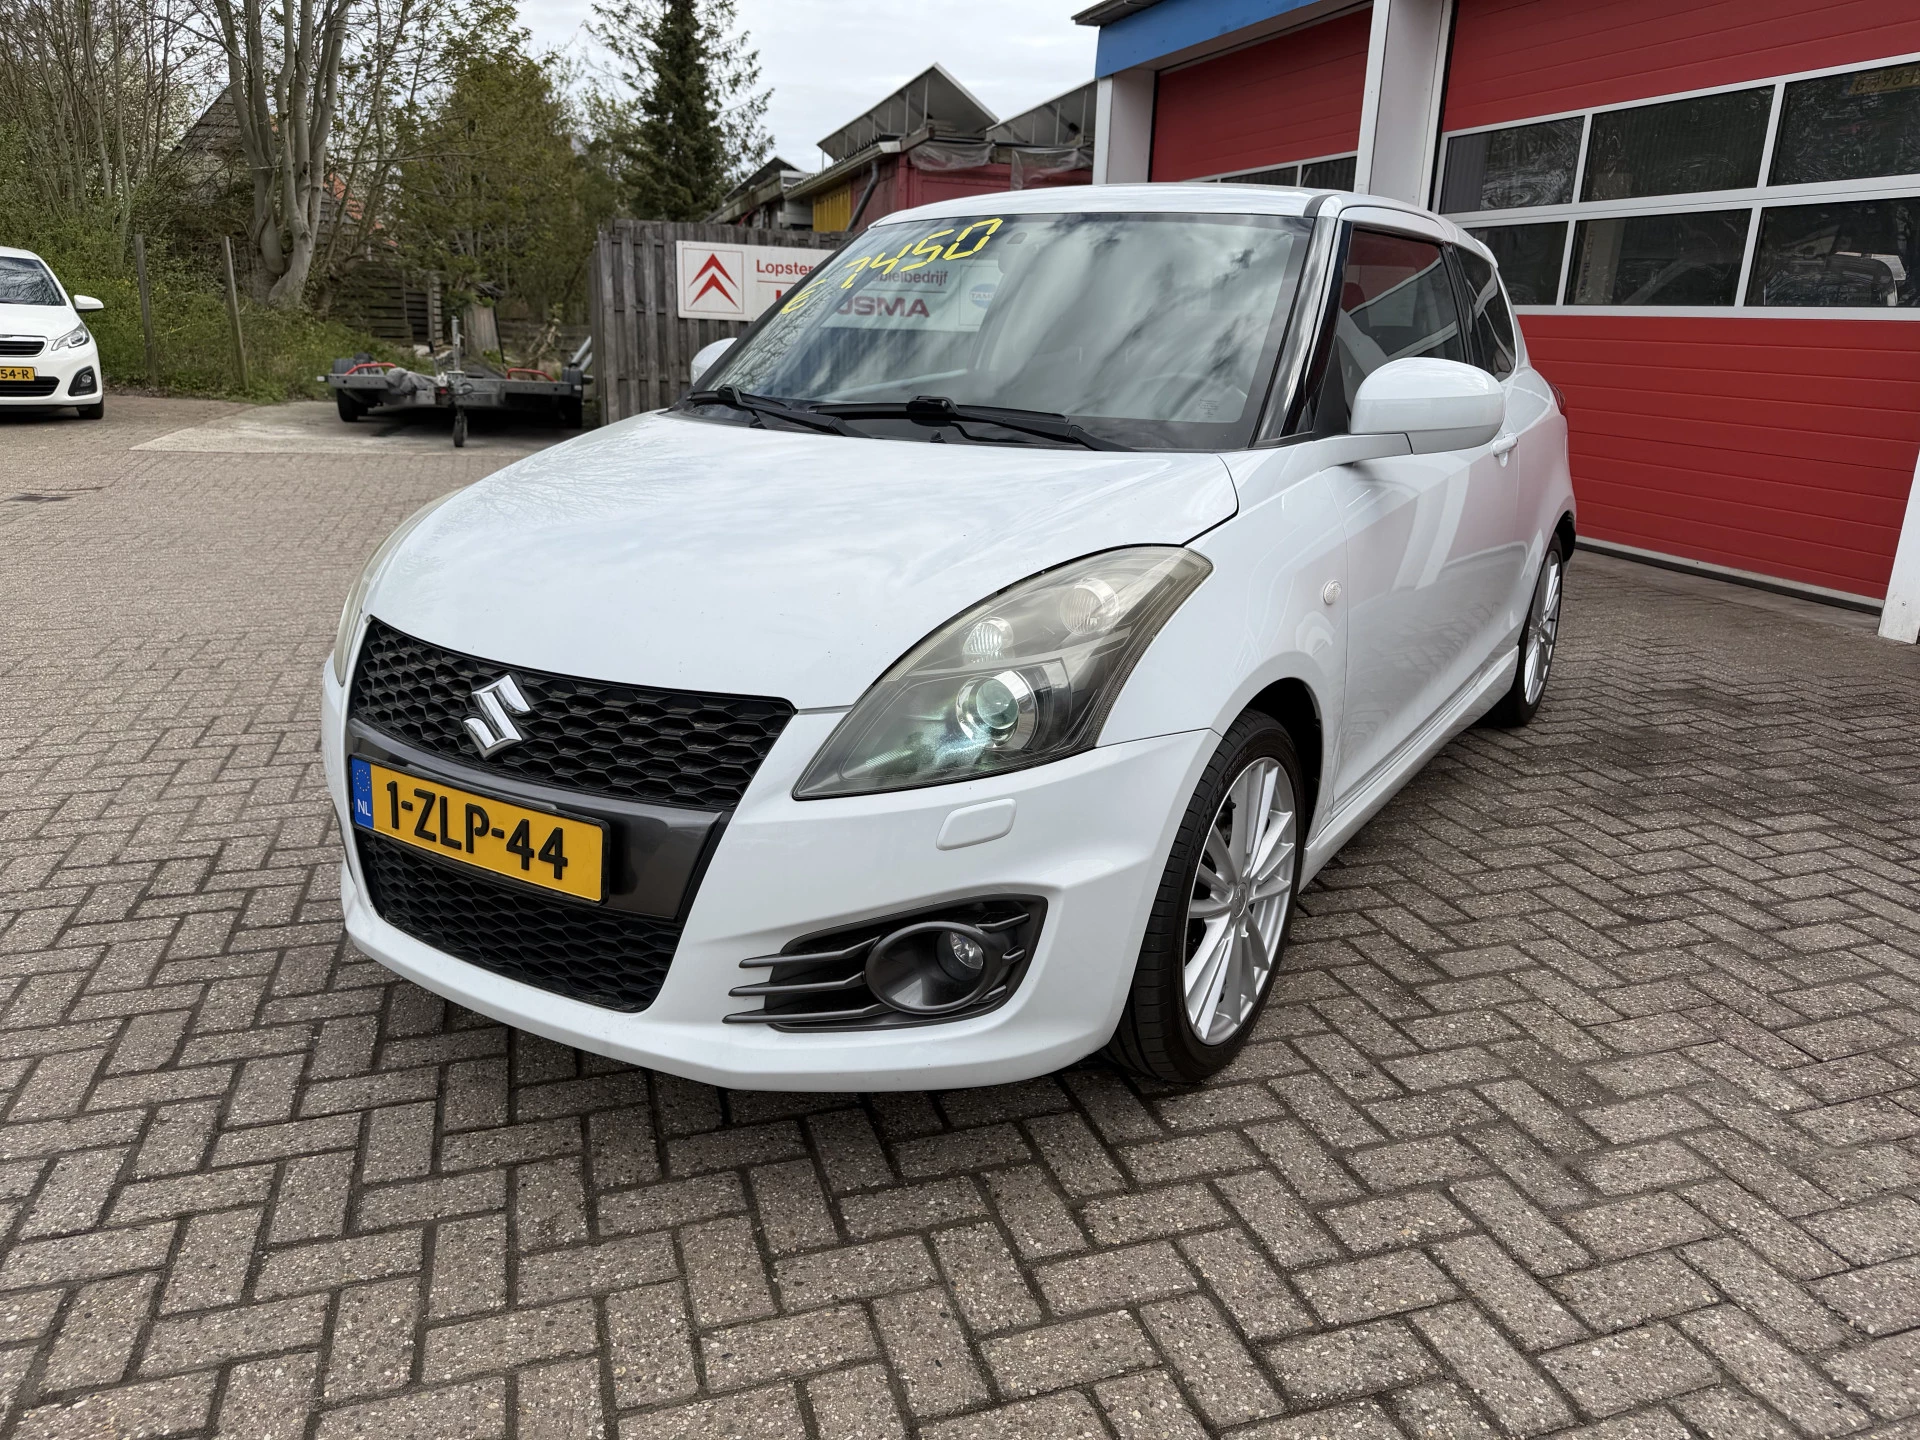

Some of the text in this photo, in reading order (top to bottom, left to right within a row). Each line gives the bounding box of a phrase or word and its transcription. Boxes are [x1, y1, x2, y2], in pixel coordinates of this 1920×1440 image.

[756, 259, 814, 276] Lopster
[0, 368, 30, 379] 54-R
[357, 798, 371, 817] NL
[386, 780, 568, 880] 1-ZLP-44
